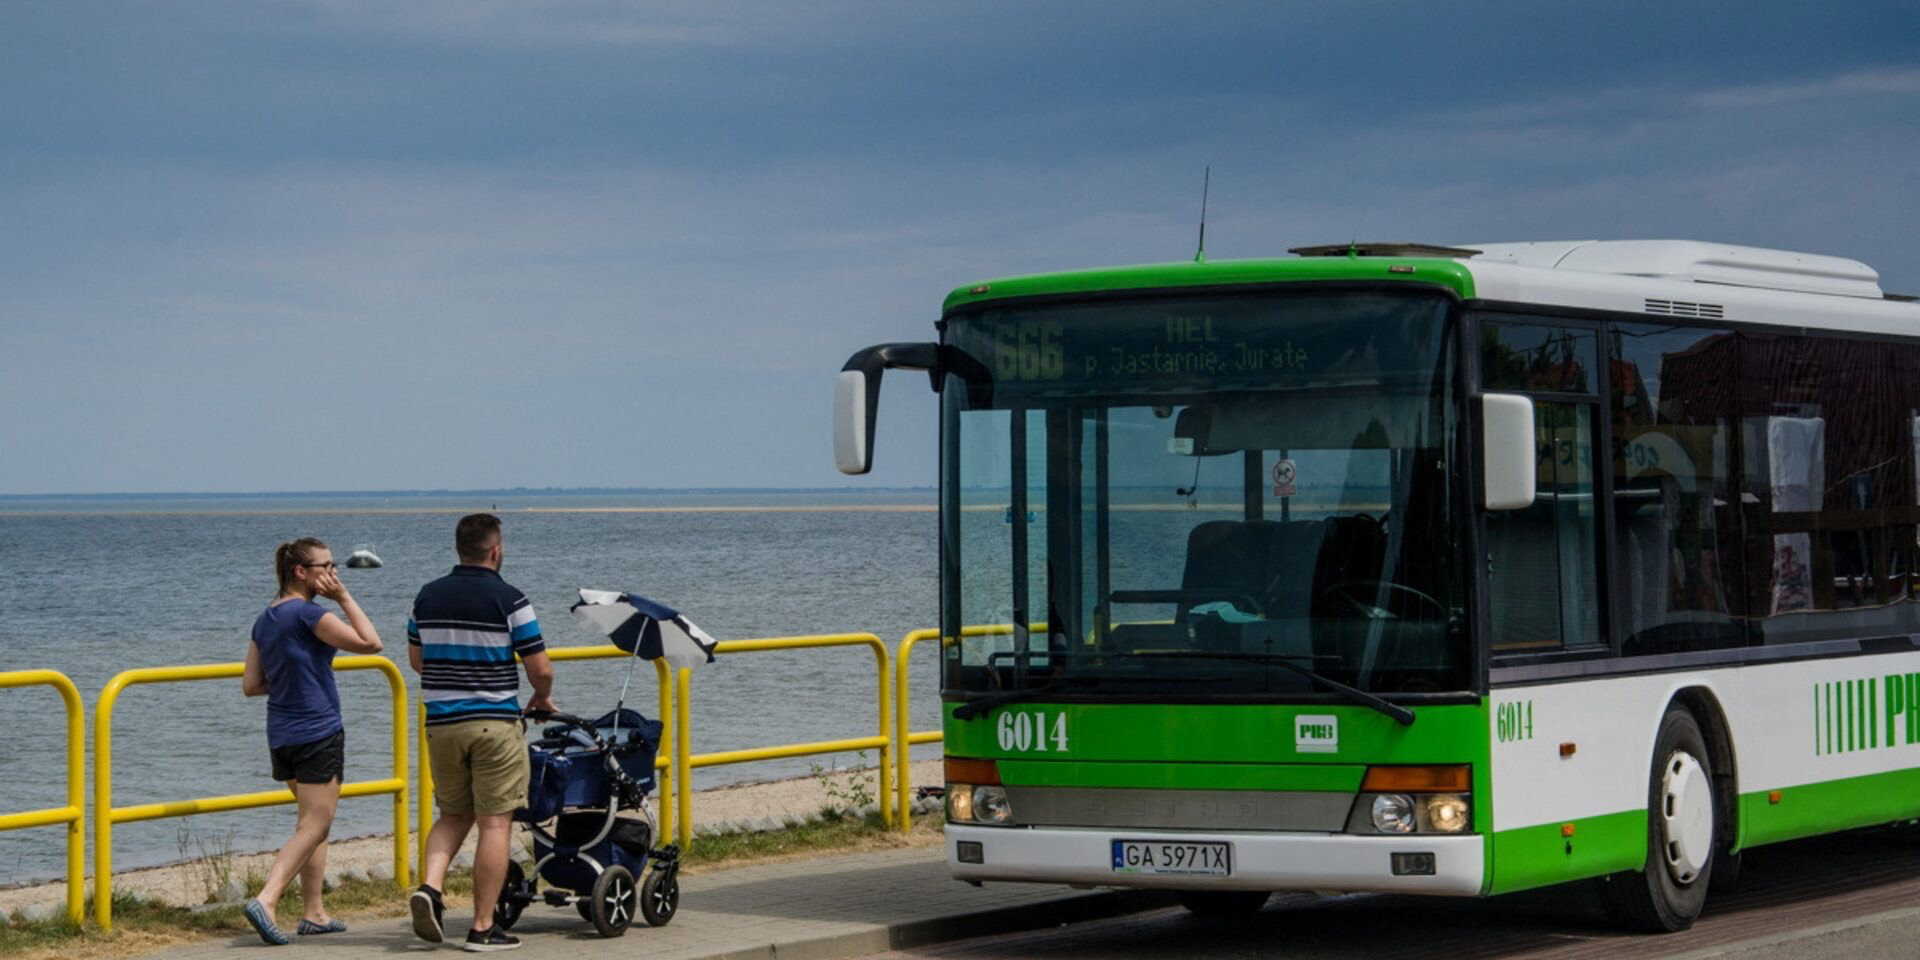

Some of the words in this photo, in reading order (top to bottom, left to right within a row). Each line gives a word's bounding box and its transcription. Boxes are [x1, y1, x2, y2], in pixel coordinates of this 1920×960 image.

[1167, 316, 1221, 343] HEL
[995, 320, 1064, 381] 666
[997, 711, 1070, 752] 6014
[1497, 699, 1534, 743] 6014
[1126, 844, 1155, 866] GA
[1162, 846, 1225, 868] 5971X
